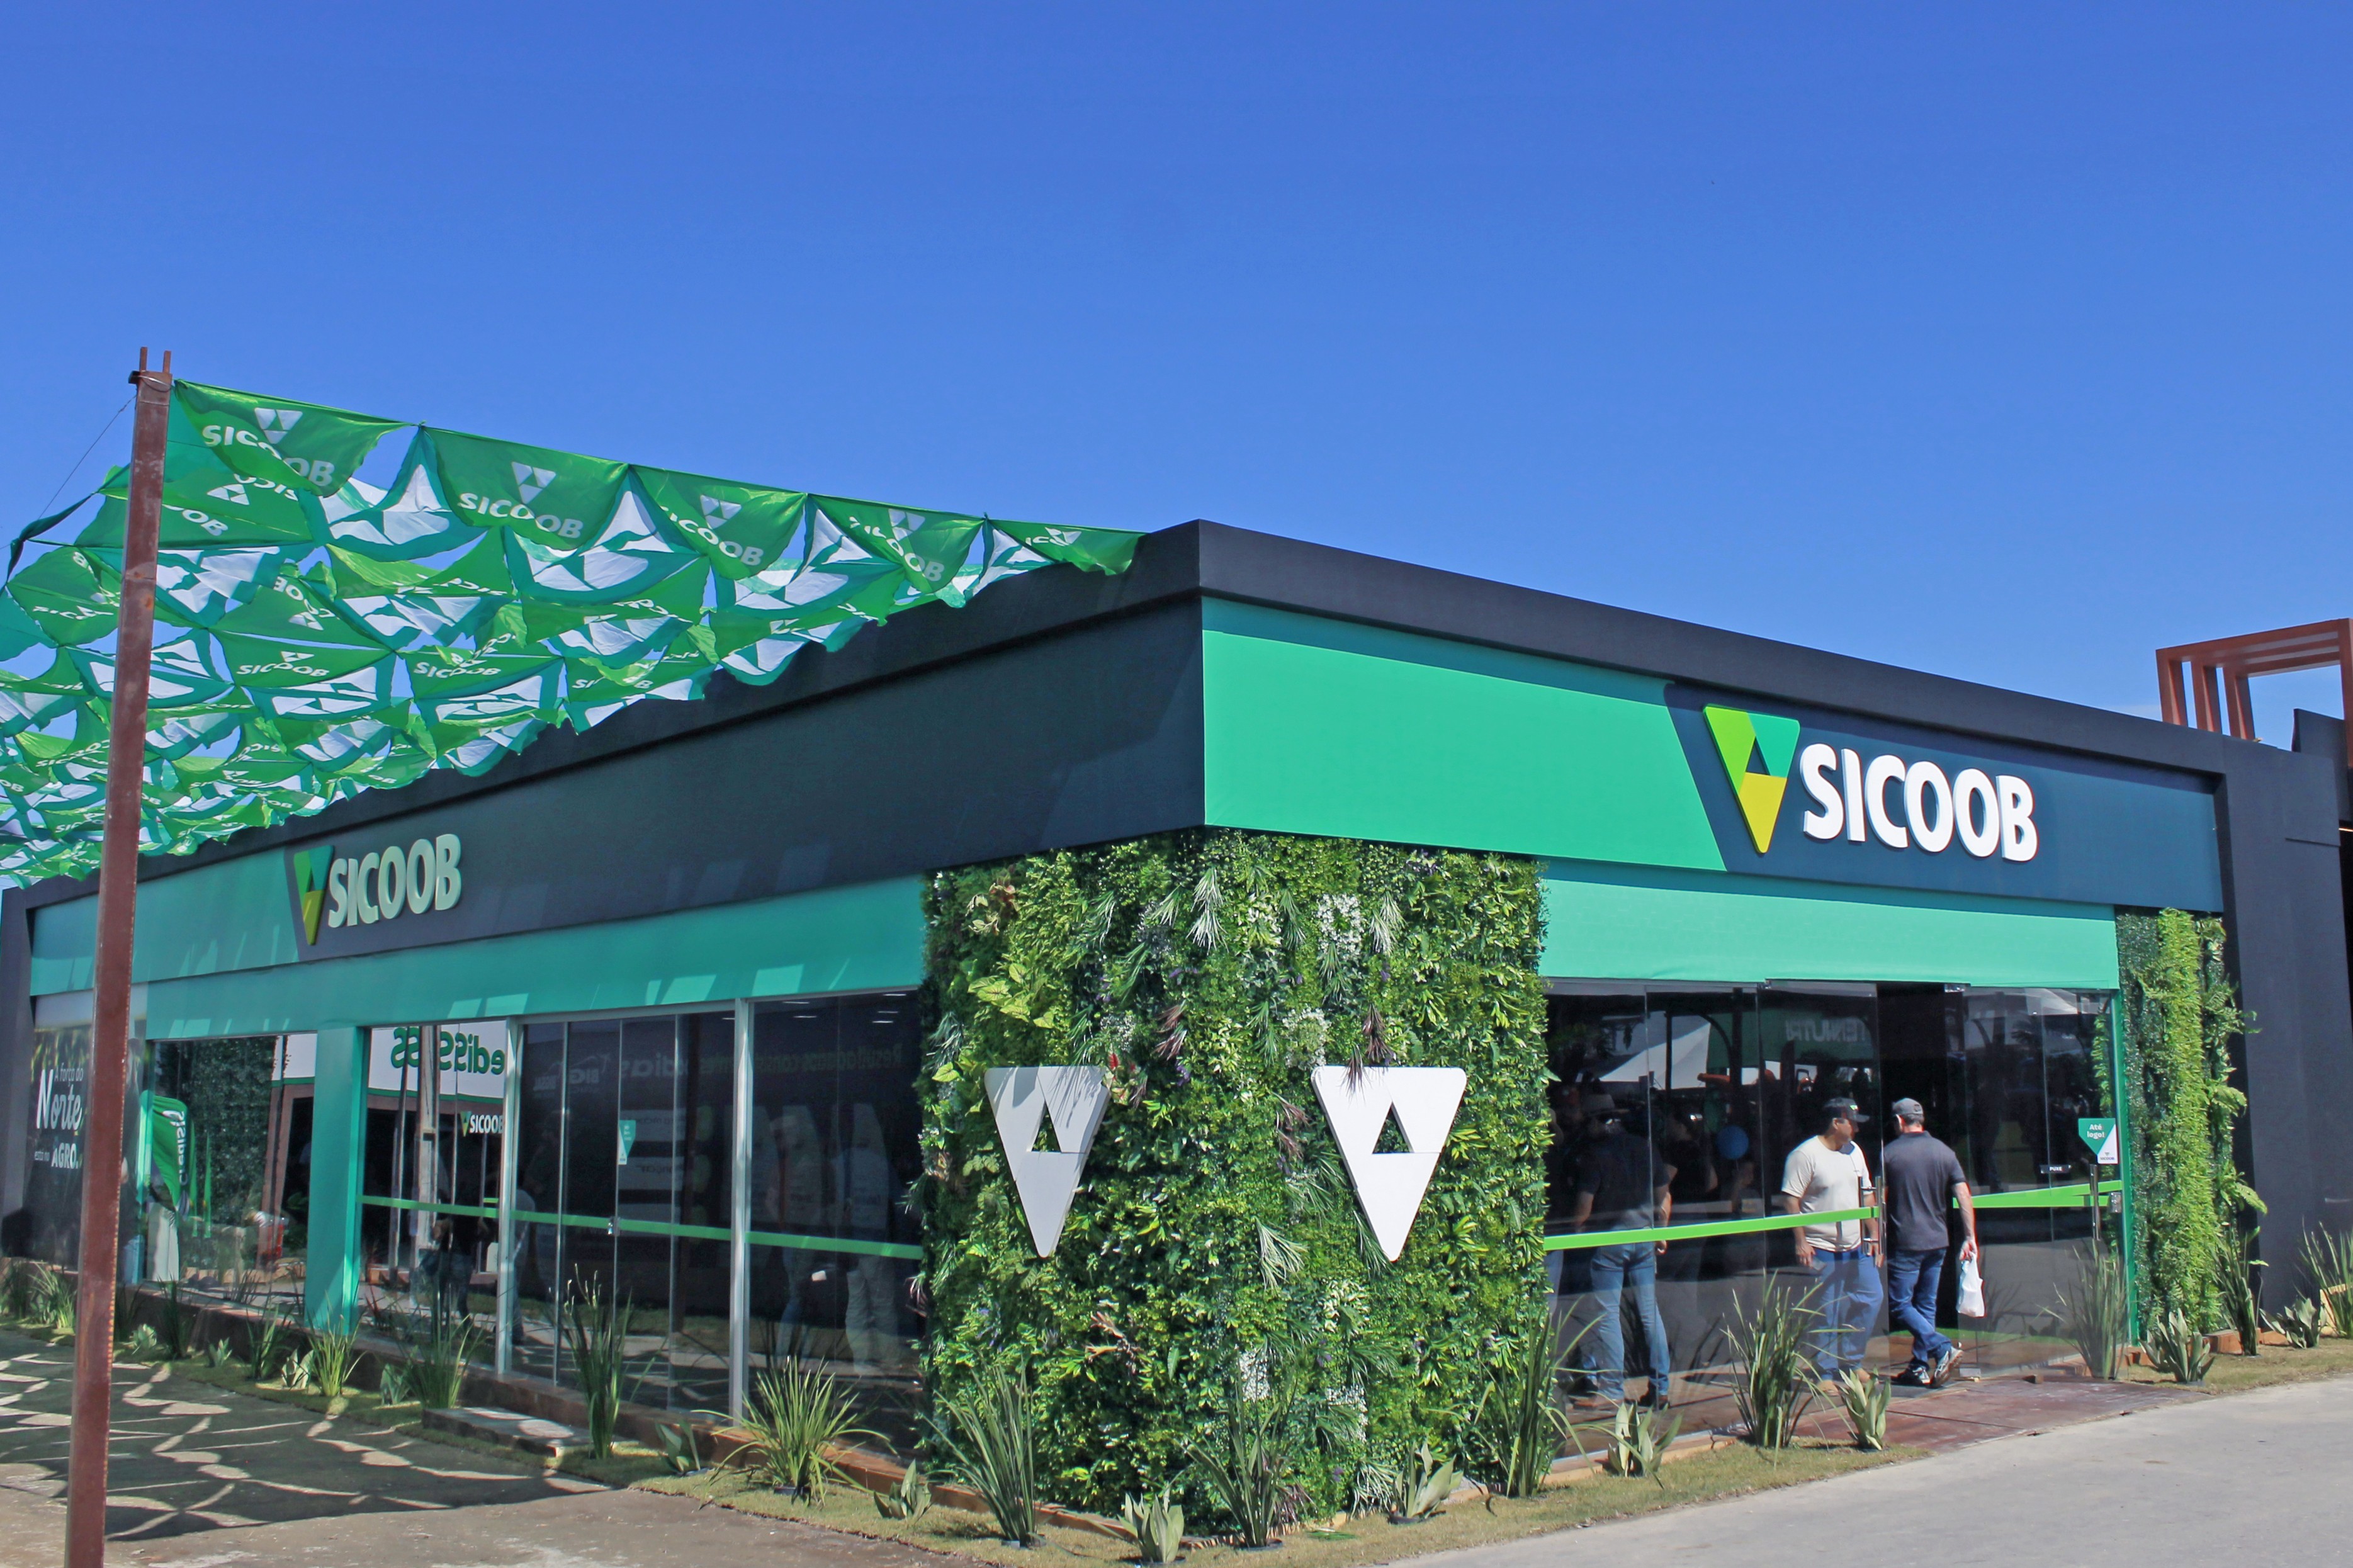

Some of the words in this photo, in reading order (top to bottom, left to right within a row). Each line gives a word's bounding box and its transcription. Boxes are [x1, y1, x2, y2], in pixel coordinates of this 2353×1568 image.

[458, 492, 584, 539] SICOOB
[658, 506, 763, 566] ICOOB
[236, 662, 330, 677] SICOOB
[1799, 743, 2038, 862] SICOOB
[328, 833, 462, 928] SICOOB
[36, 1069, 82, 1131] Norte
[51, 1142, 79, 1170] AGRO.
[2087, 1131, 2105, 1139] logo!
